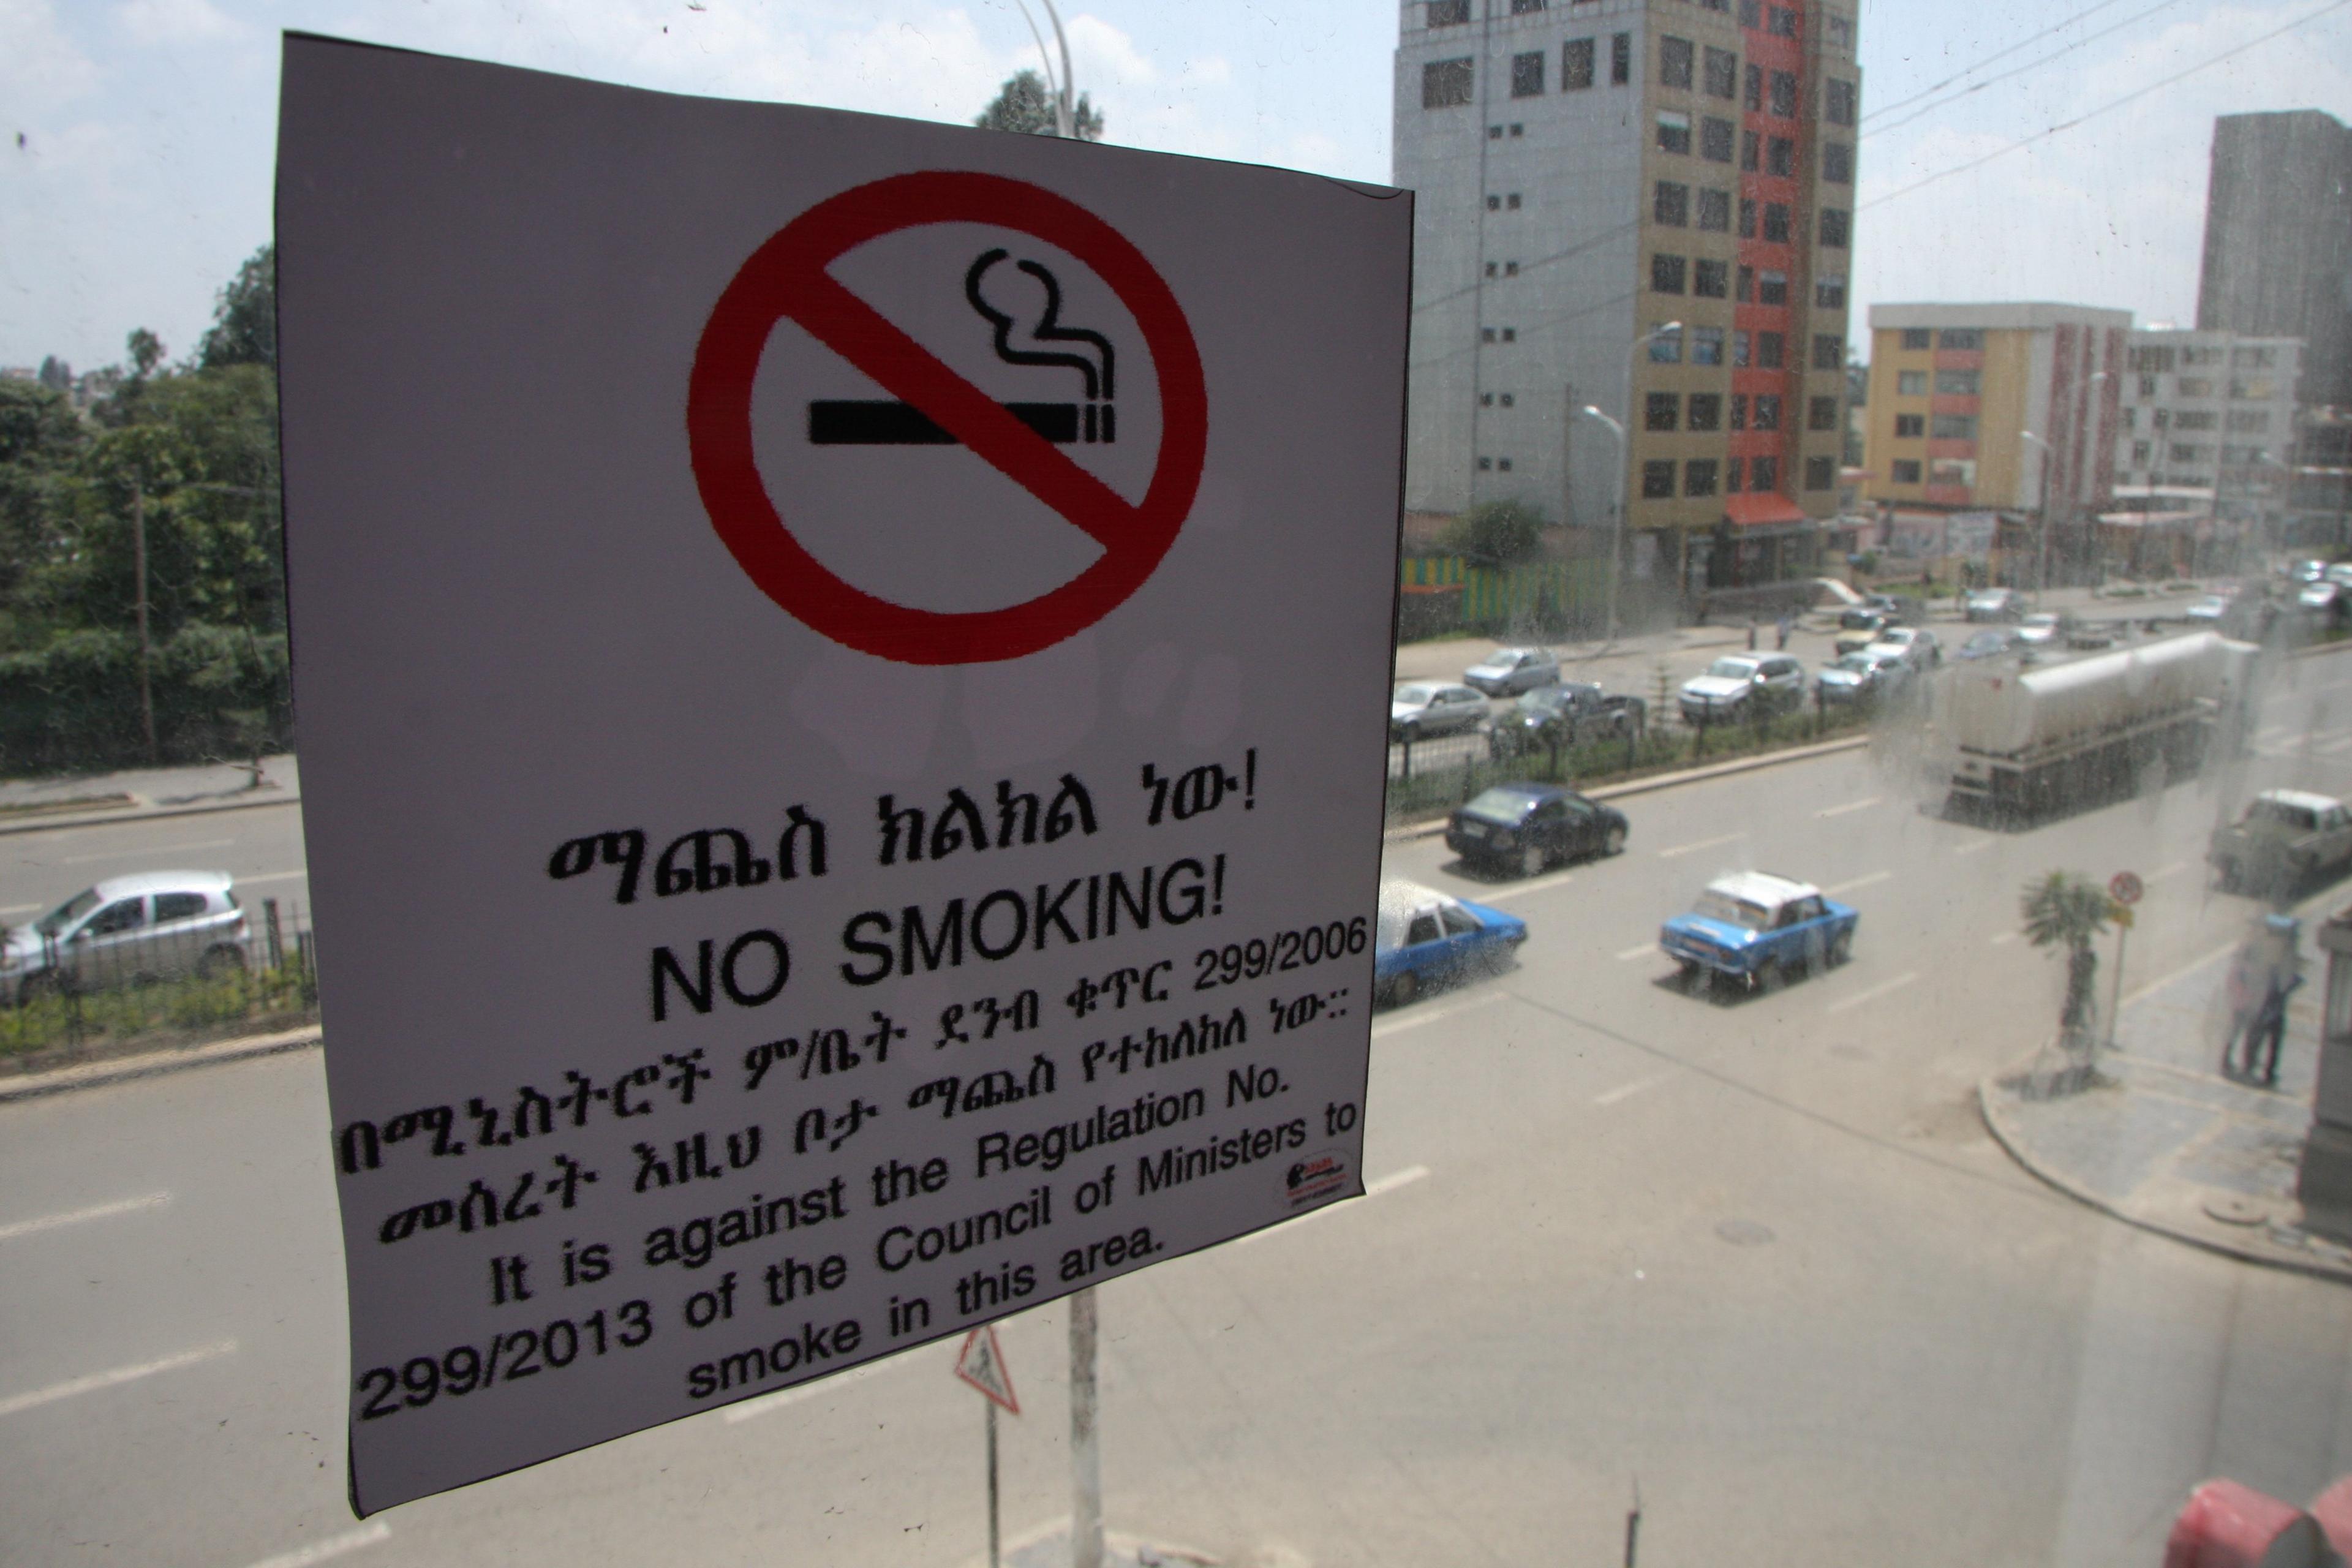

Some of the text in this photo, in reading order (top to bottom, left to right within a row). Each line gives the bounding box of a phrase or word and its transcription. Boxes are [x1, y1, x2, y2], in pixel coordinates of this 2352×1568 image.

[546, 747, 1257, 905] ማጨስ ክልክል ነው!
[651, 853, 1226, 1022] NO SMOKING!
[338, 916, 1367, 1174] በሚኒስትሮች ም/ቤት ደንብ ቁጥር 299/2006
[794, 1099, 878, 1154] ቦታ
[907, 1053, 1055, 1118] ማጨስ
[1082, 1008, 1247, 1083] የተከለከለ
[356, 1298, 654, 1422] 299/2013
[684, 1272, 737, 1329] of
[763, 1254, 847, 1306] the
[876, 1188, 1052, 1273] Council
[1074, 1164, 1115, 1215] of
[1138, 1117, 1307, 1196] Ministers
[1325, 1102, 1357, 1137] to
[490, 1065, 1289, 1305] It is against the Regulation No.
[687, 1227, 1163, 1400] smoke in this area.
